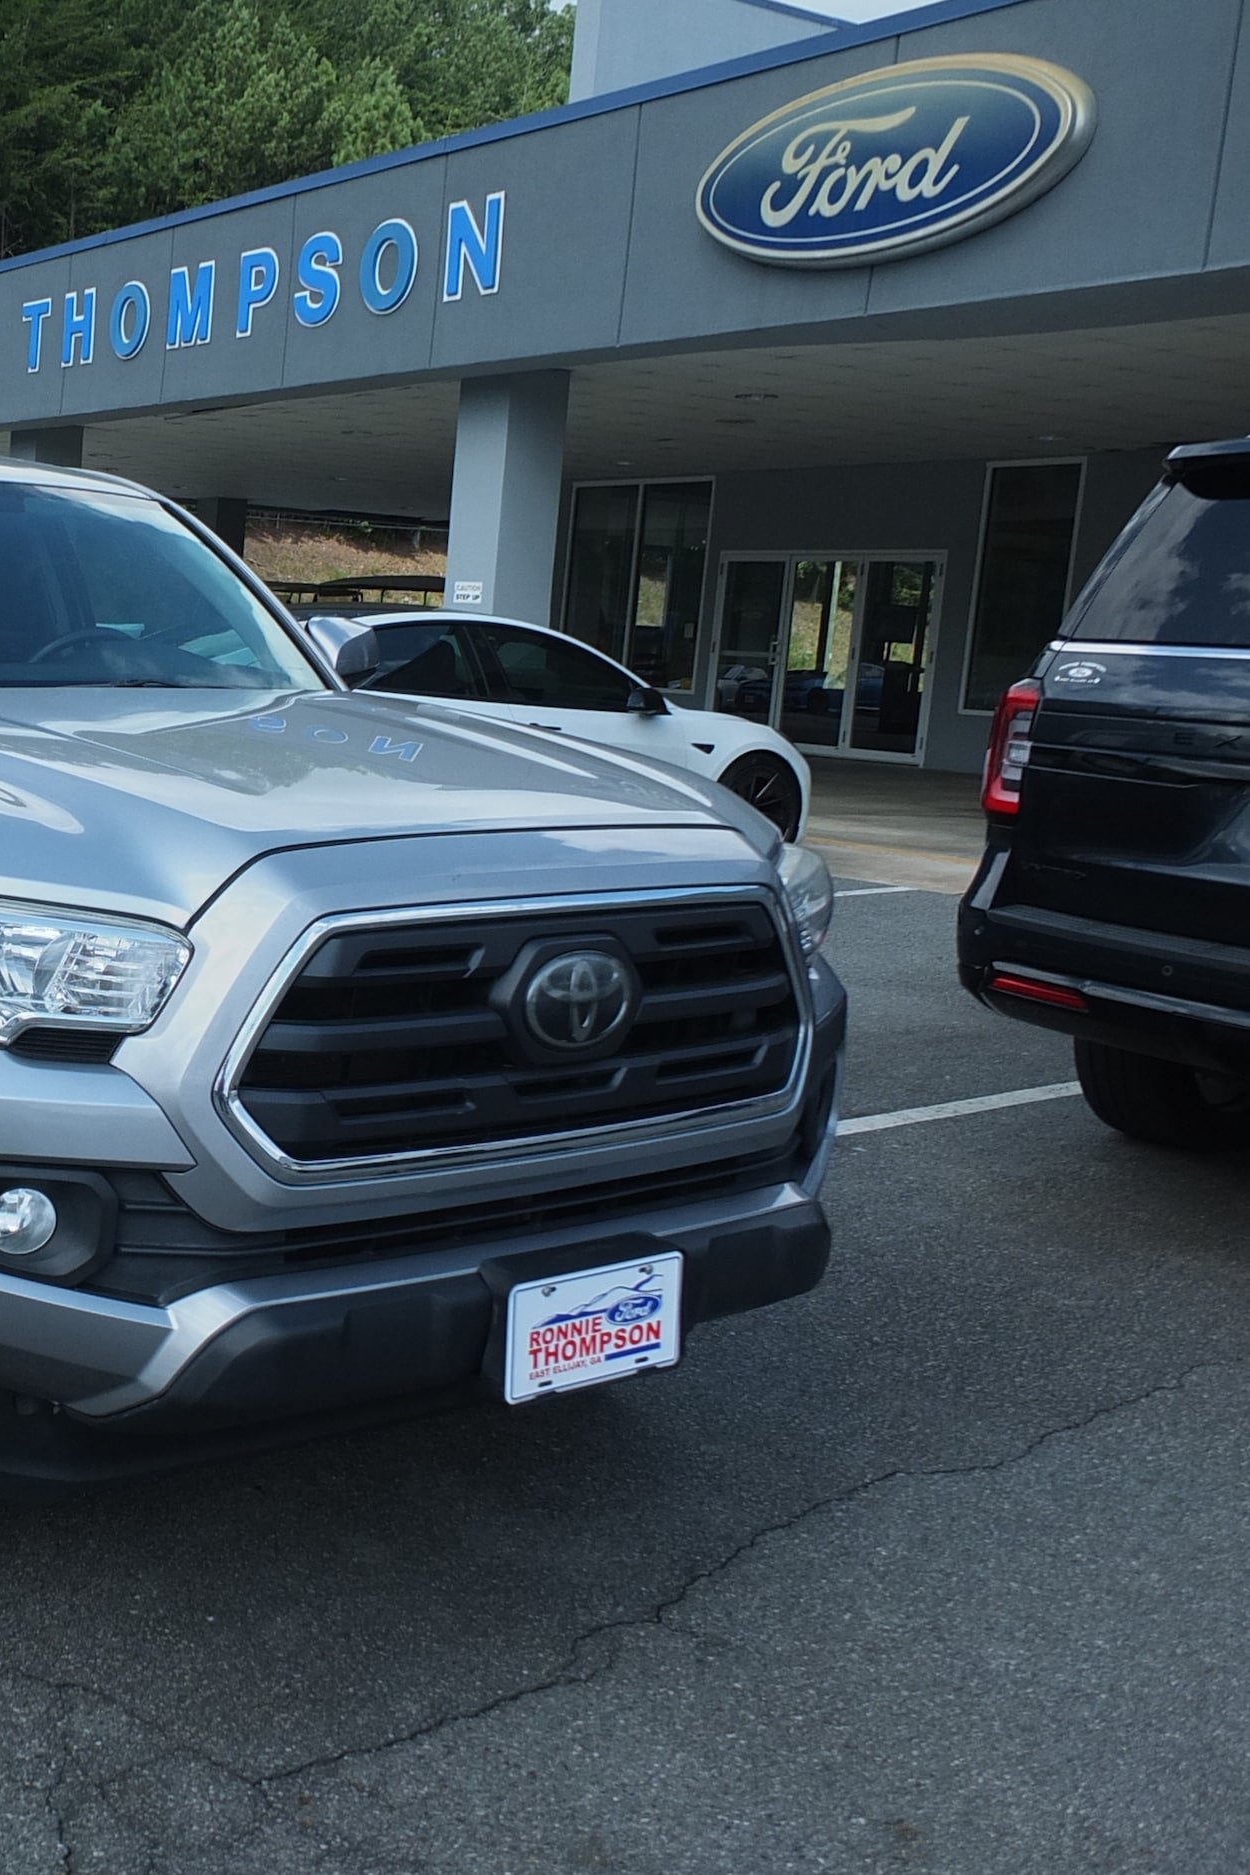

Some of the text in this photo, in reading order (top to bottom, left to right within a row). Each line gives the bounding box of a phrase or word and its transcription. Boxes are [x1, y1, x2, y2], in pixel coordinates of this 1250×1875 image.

[760, 106, 971, 228] Ford
[22, 190, 506, 373] THOMPSON
[614, 1300, 652, 1321] Ford
[528, 1316, 603, 1348] RONNIE
[528, 1320, 662, 1369] THOMPSON
[529, 1367, 551, 1380] EAST
[589, 1356, 603, 1366] GA
